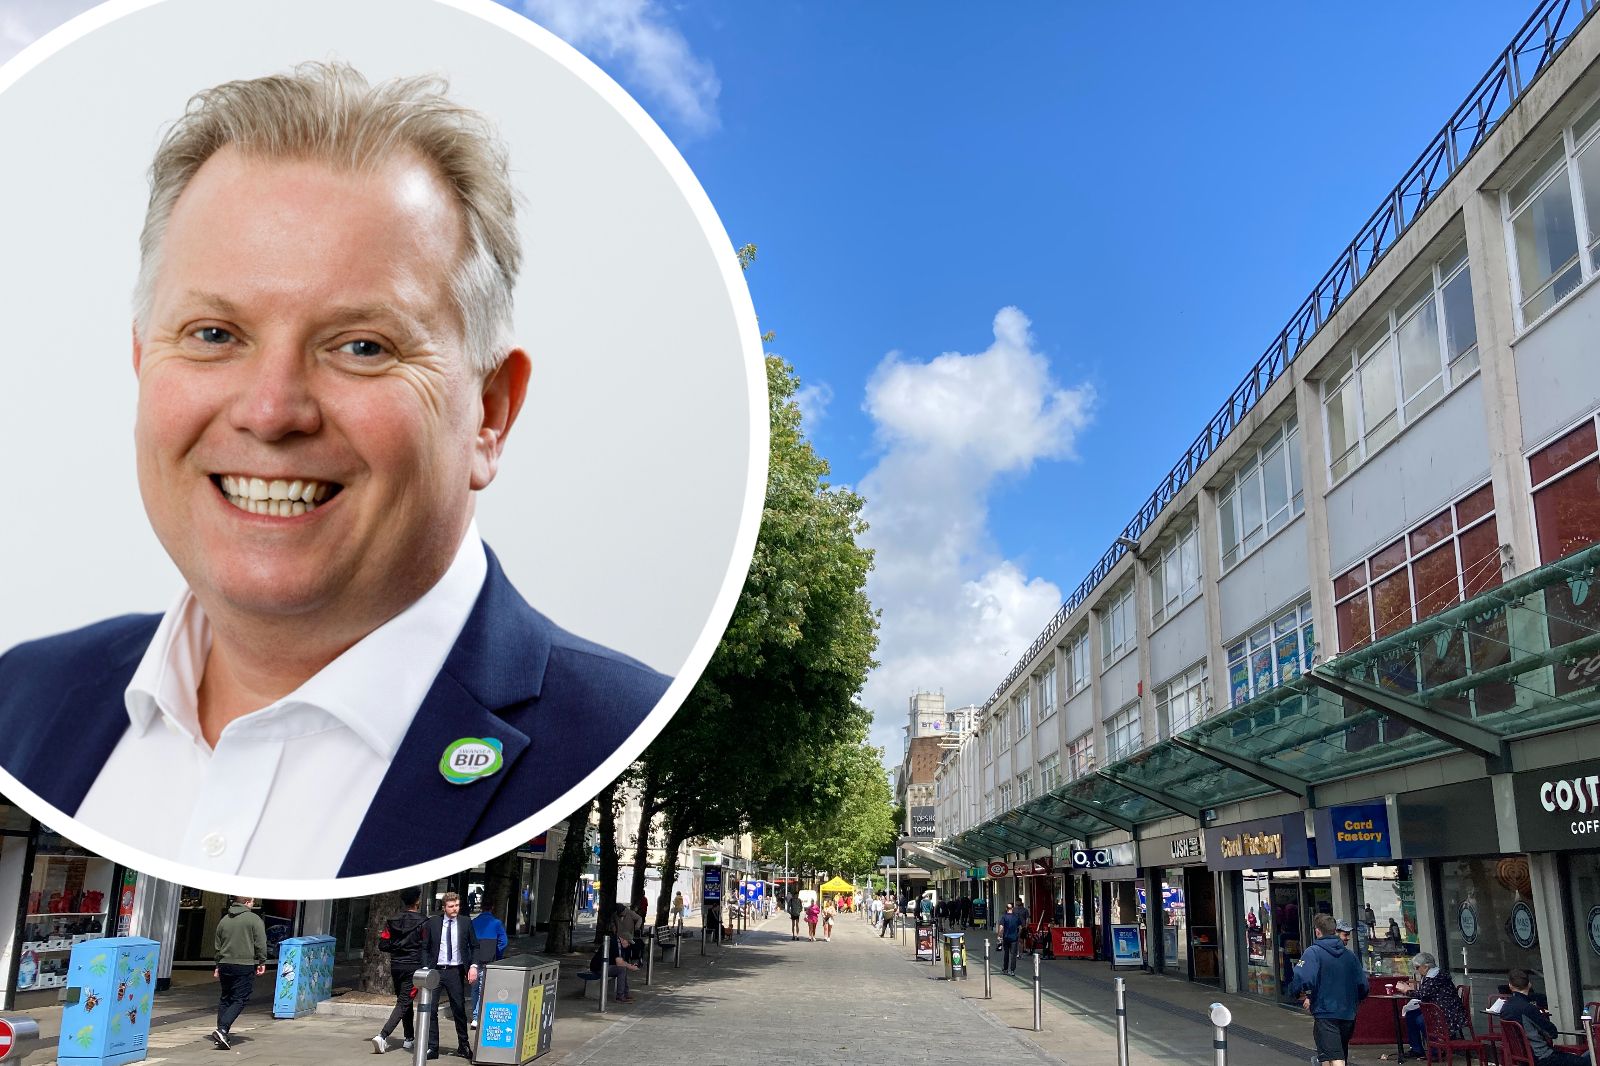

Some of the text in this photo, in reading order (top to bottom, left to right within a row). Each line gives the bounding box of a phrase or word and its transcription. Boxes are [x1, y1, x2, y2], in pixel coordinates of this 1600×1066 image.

[455, 754, 489, 766] BID
[1540, 775, 1599, 813] COST
[1344, 820, 1373, 830] Card
[1337, 831, 1382, 841] Factory
[1170, 838, 1189, 858] LUSH
[1221, 834, 1242, 858] Card
[1243, 831, 1281, 859] Factory
